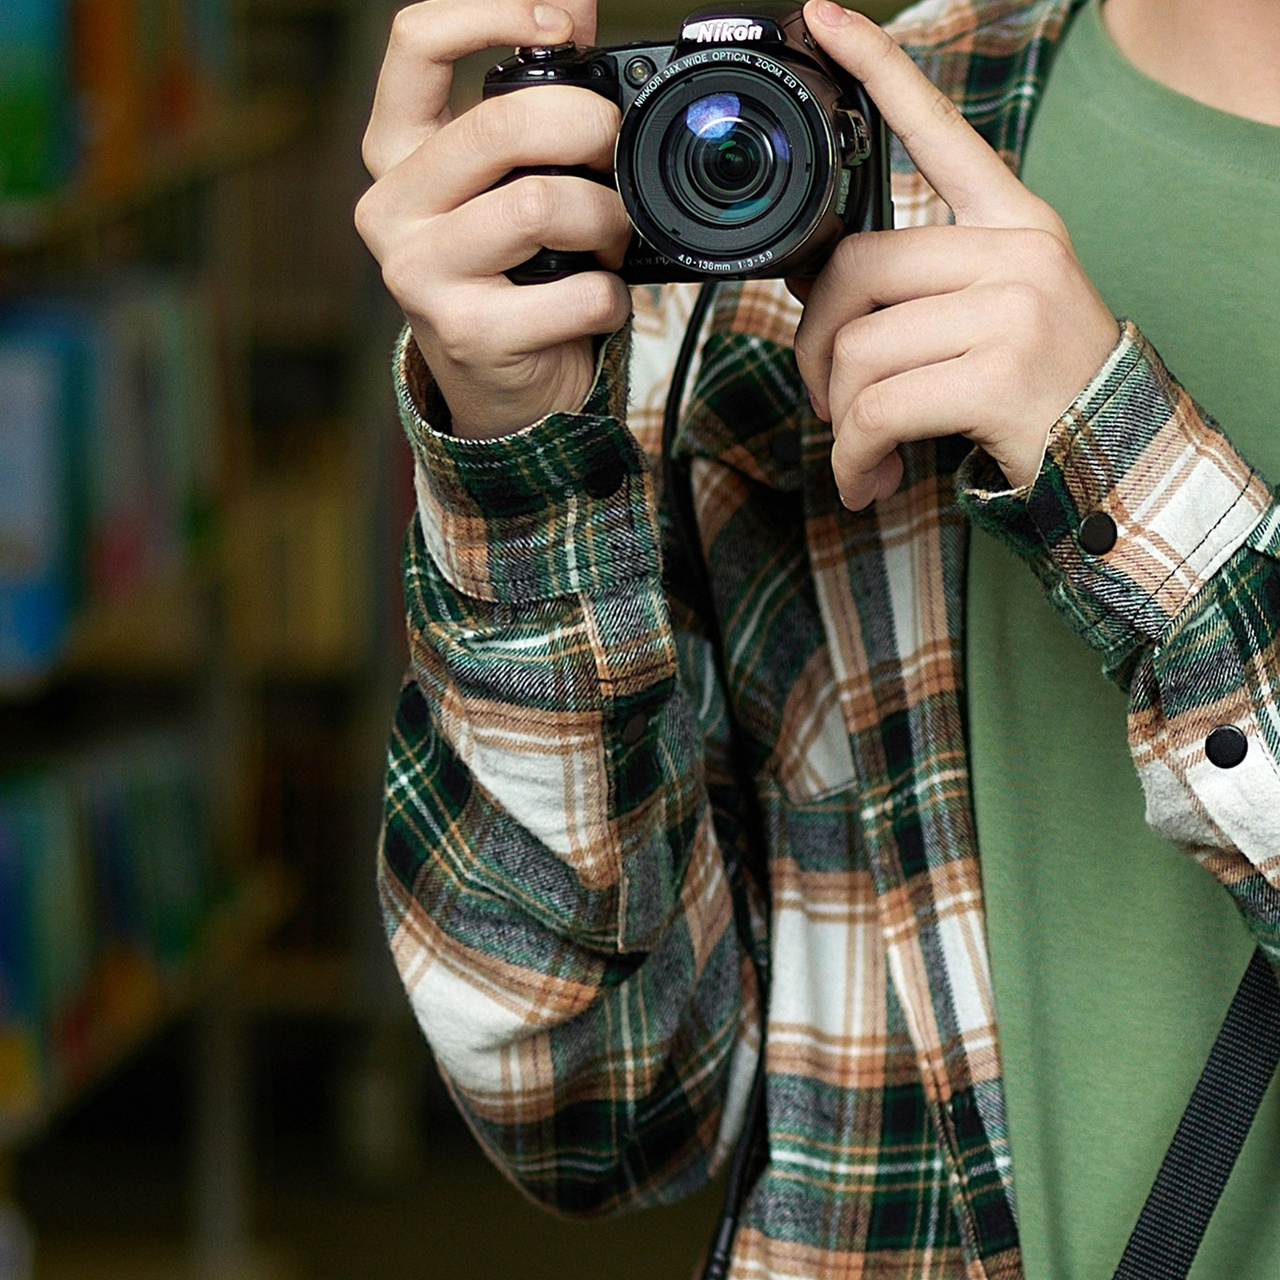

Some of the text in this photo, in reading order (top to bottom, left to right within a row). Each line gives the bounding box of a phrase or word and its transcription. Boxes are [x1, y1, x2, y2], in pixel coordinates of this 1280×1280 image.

[697, 22, 763, 43] Nikon
[634, 51, 809, 108] NIKKOR 34X WIDE OPTICAL ZOOM ED VR
